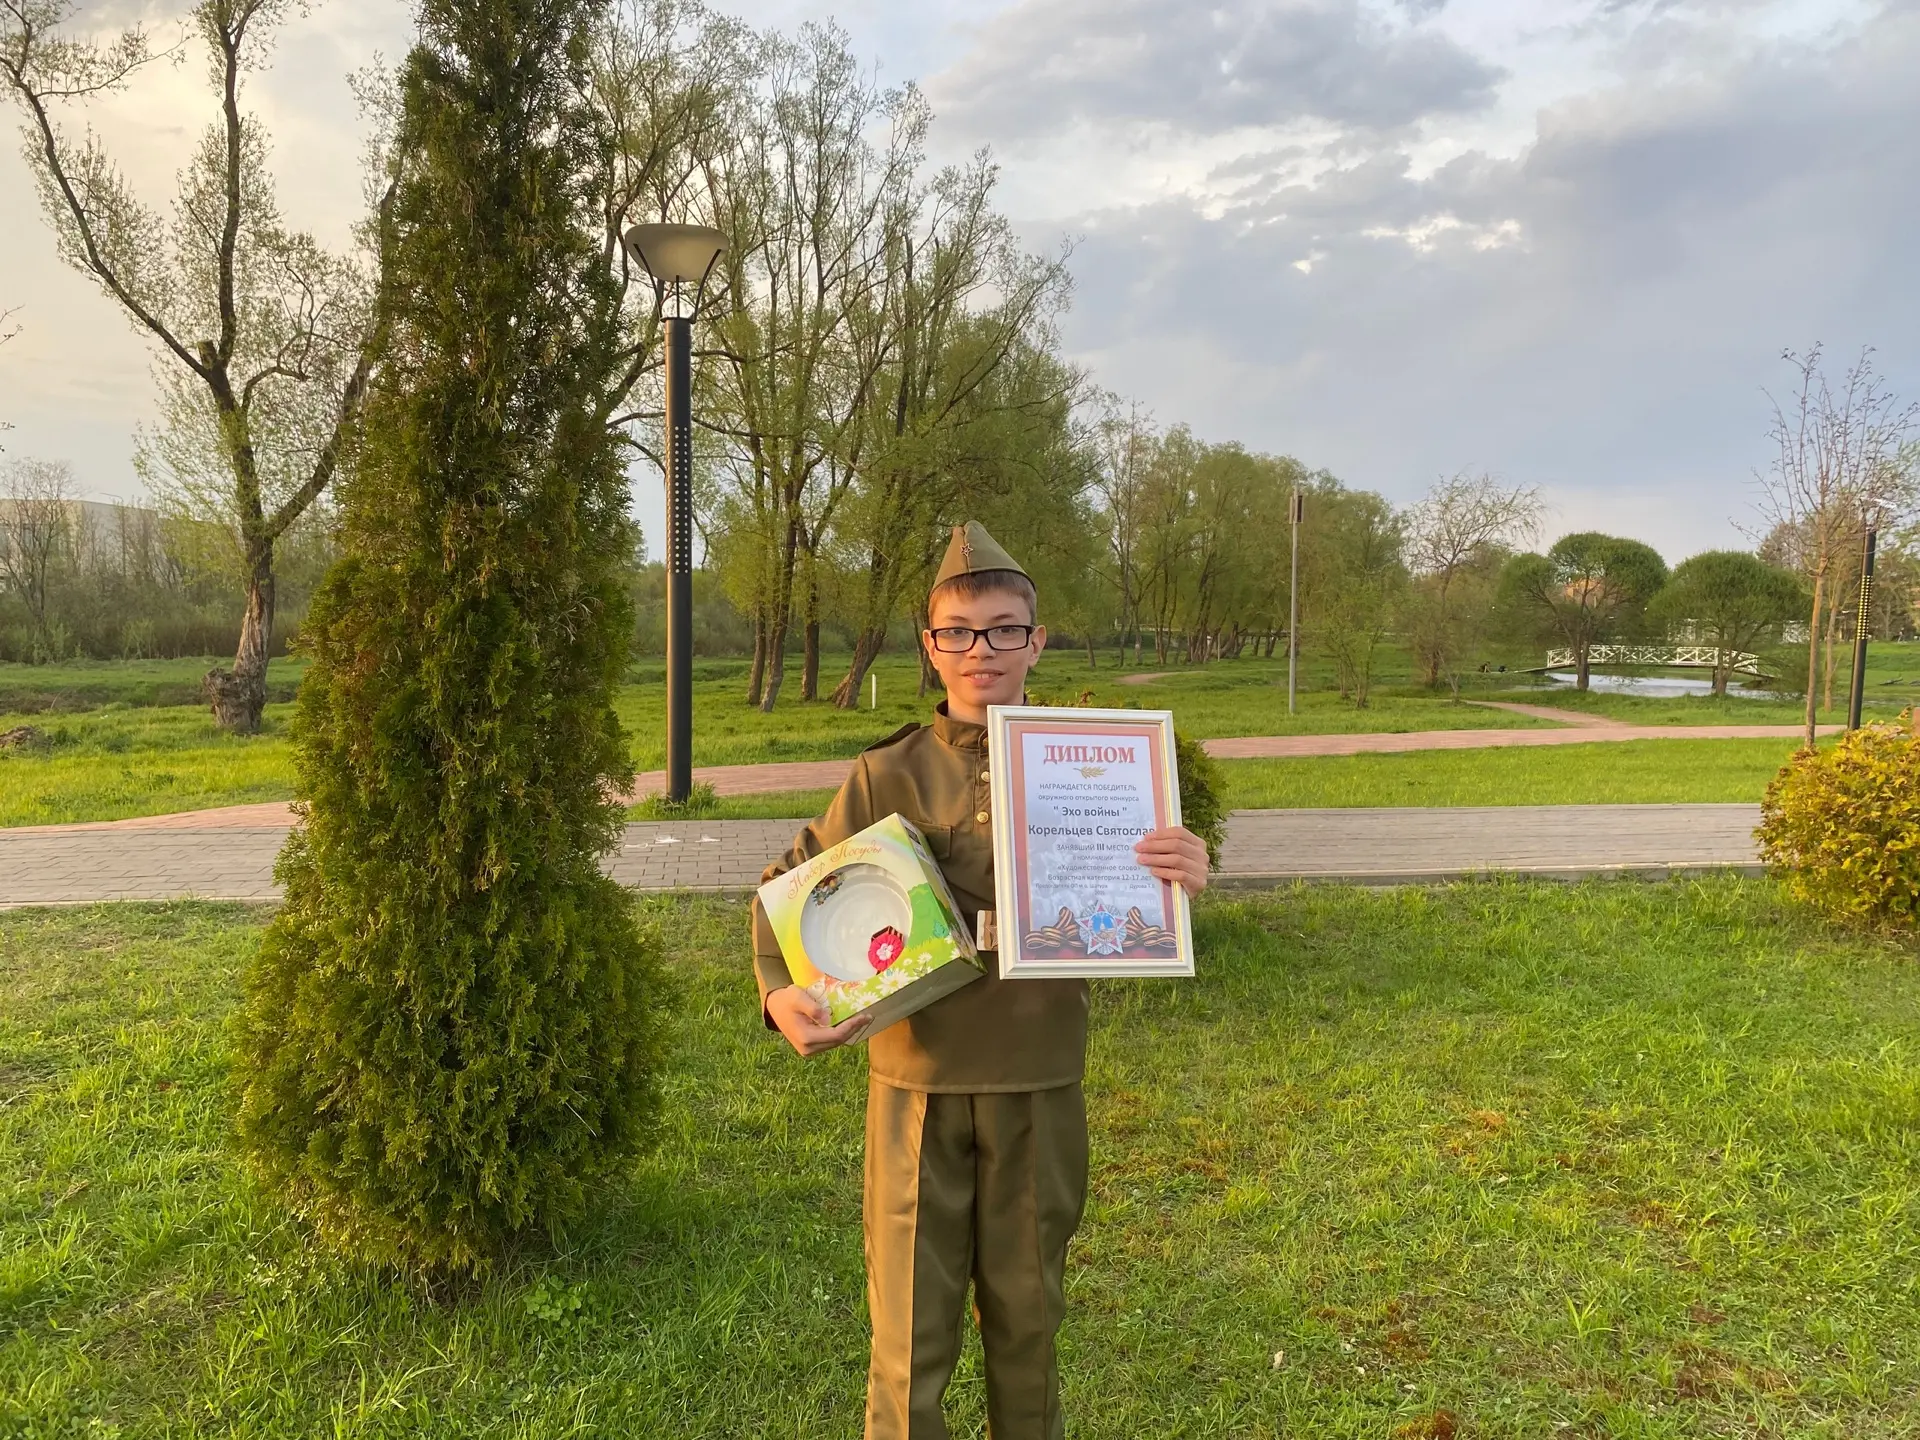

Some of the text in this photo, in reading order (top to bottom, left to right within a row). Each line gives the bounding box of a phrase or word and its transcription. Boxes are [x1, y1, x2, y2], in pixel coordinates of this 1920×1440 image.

[1044, 744, 1135, 764] ДИПЛОМ
[1040, 783, 1137, 792] НАГРАЖДАЕТСЯ ПОБЕДИТЕЛЬ
[1062, 807, 1081, 816] Эхо
[1084, 807, 1120, 817] войны
[1028, 825, 1093, 837] Корельцев
[788, 840, 882, 900] Набор Посуды
[1058, 864, 1117, 872] «Художественное
